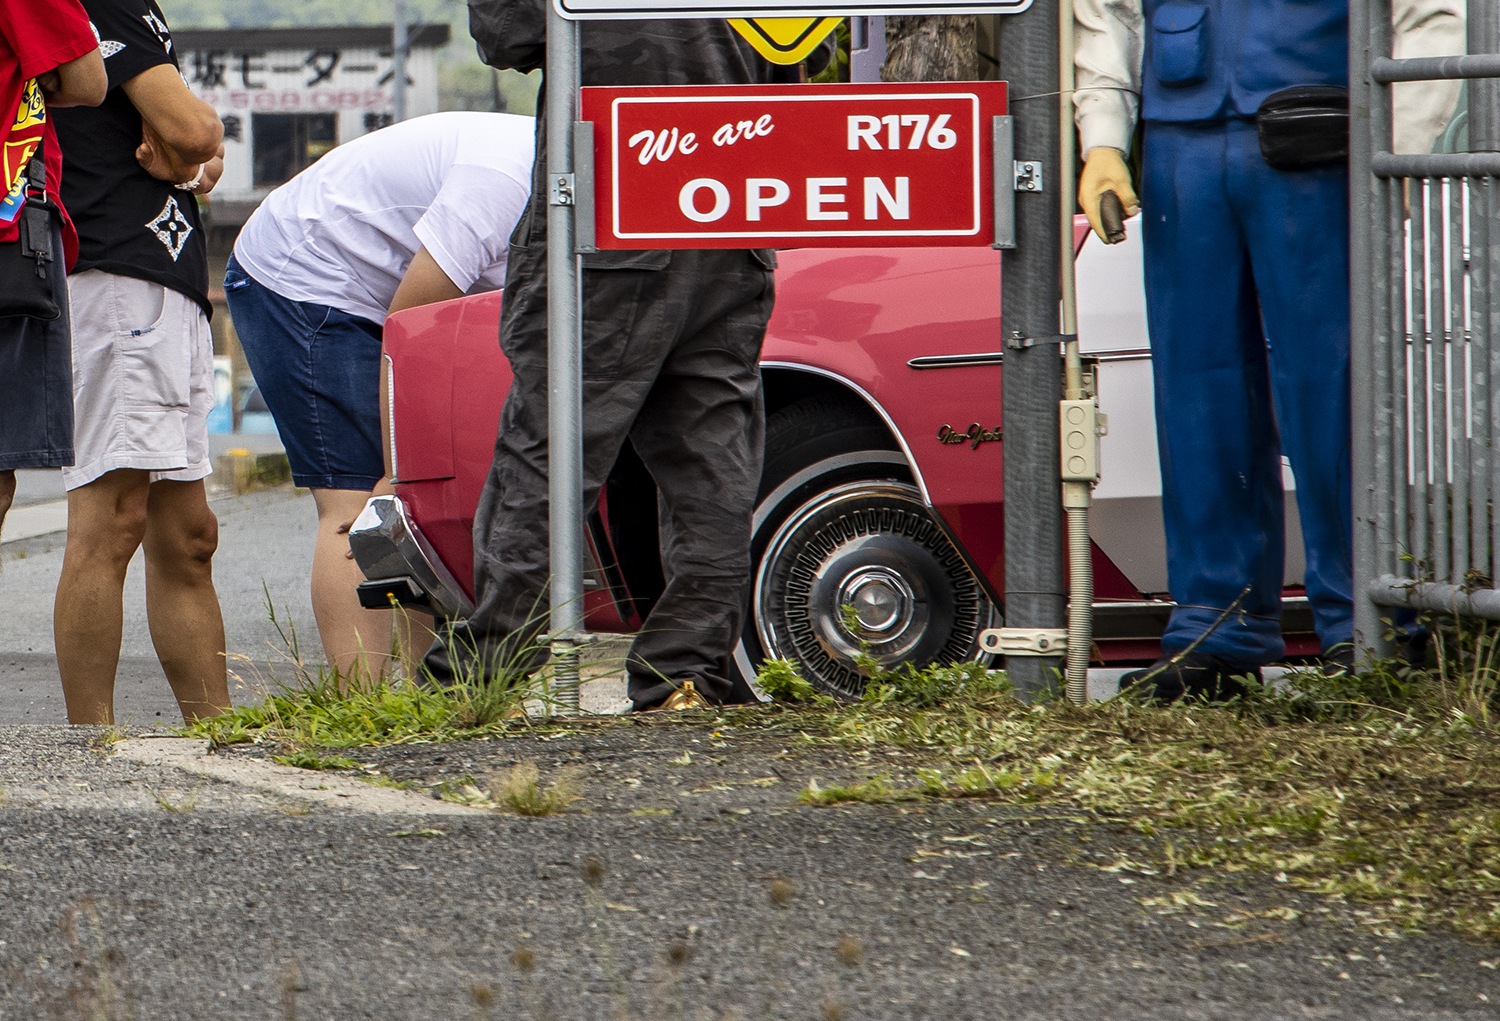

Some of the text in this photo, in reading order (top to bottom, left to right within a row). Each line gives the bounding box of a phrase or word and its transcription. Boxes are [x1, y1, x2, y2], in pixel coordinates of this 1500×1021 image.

[628, 113, 958, 166] We are R176
[678, 176, 910, 222] OPEN
